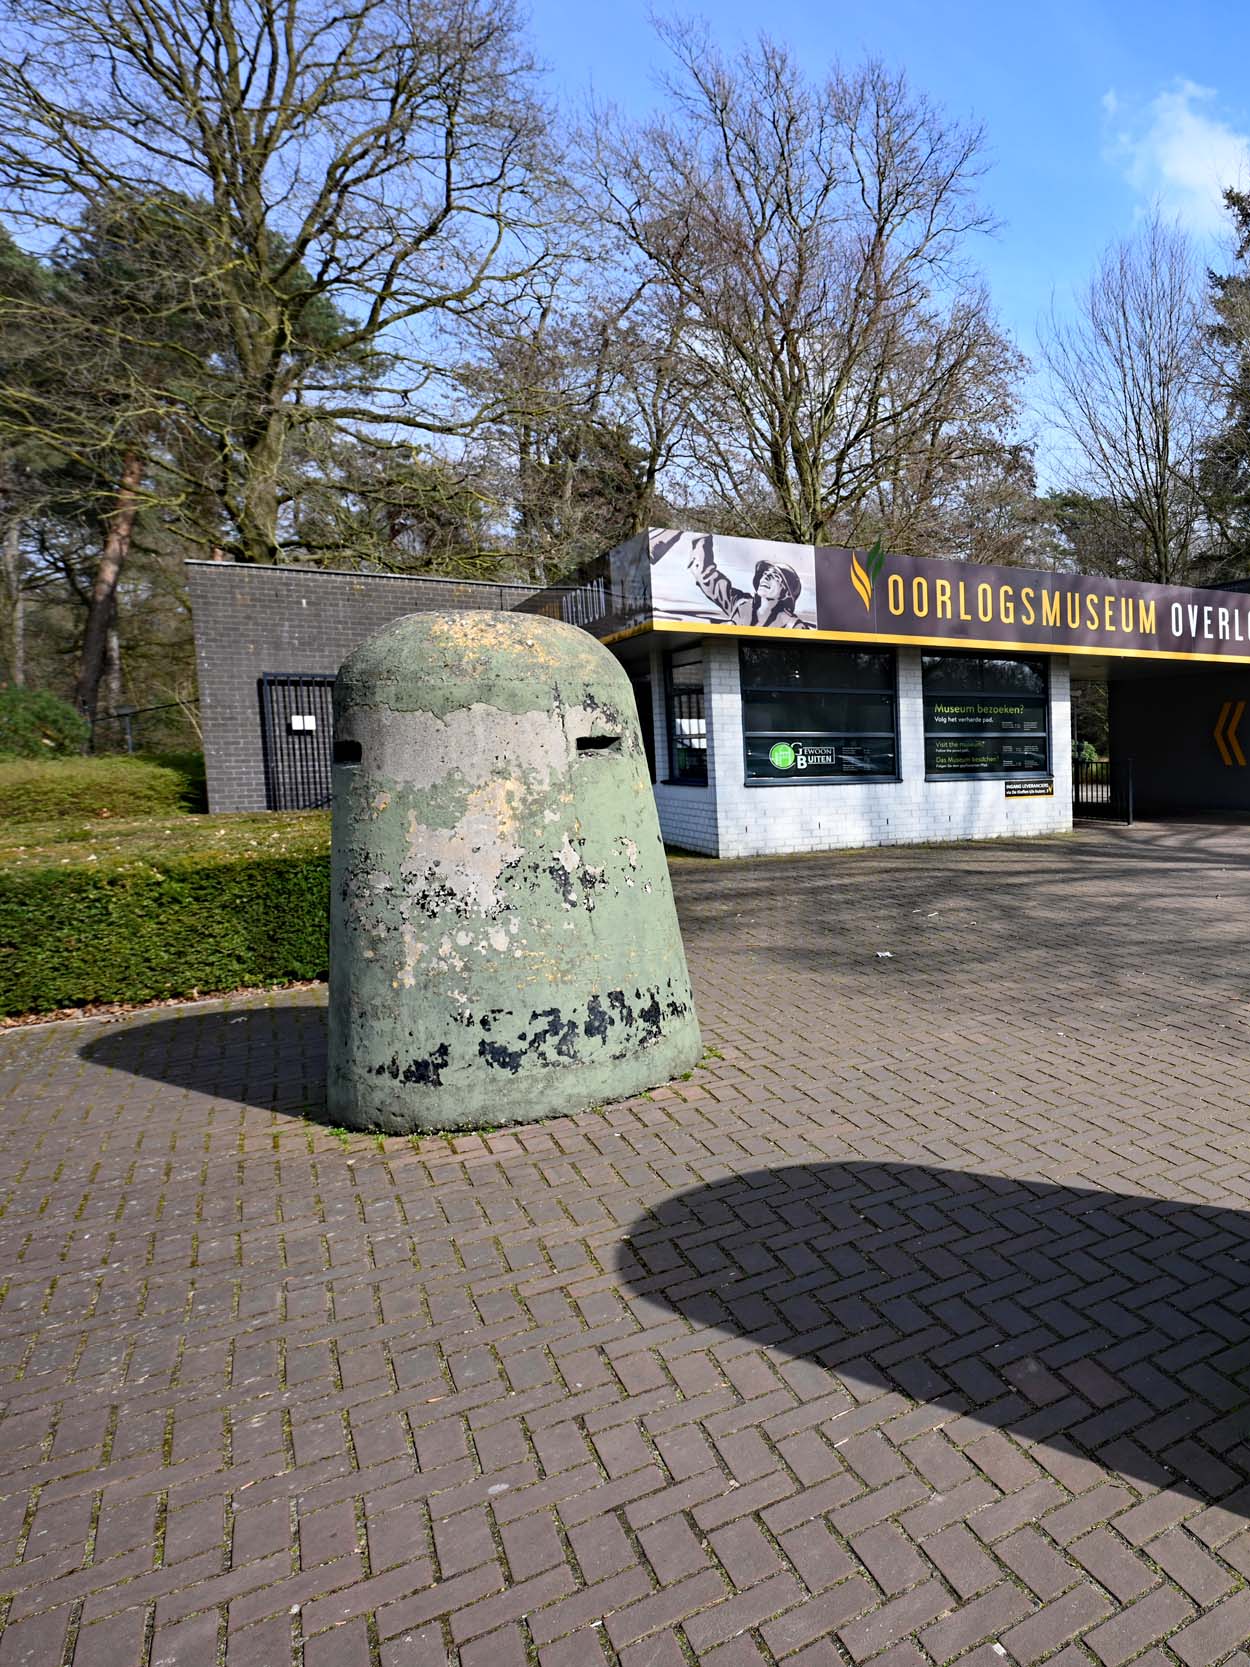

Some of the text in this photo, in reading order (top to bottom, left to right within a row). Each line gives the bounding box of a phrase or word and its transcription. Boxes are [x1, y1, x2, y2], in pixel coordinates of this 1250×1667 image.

[887, 573, 1157, 636] OORLOGSMUSEUM
[934, 703, 1025, 714] Museum bezoeken?
[790, 742, 832, 756] GEWOON
[796, 755, 832, 769] BUITEN
